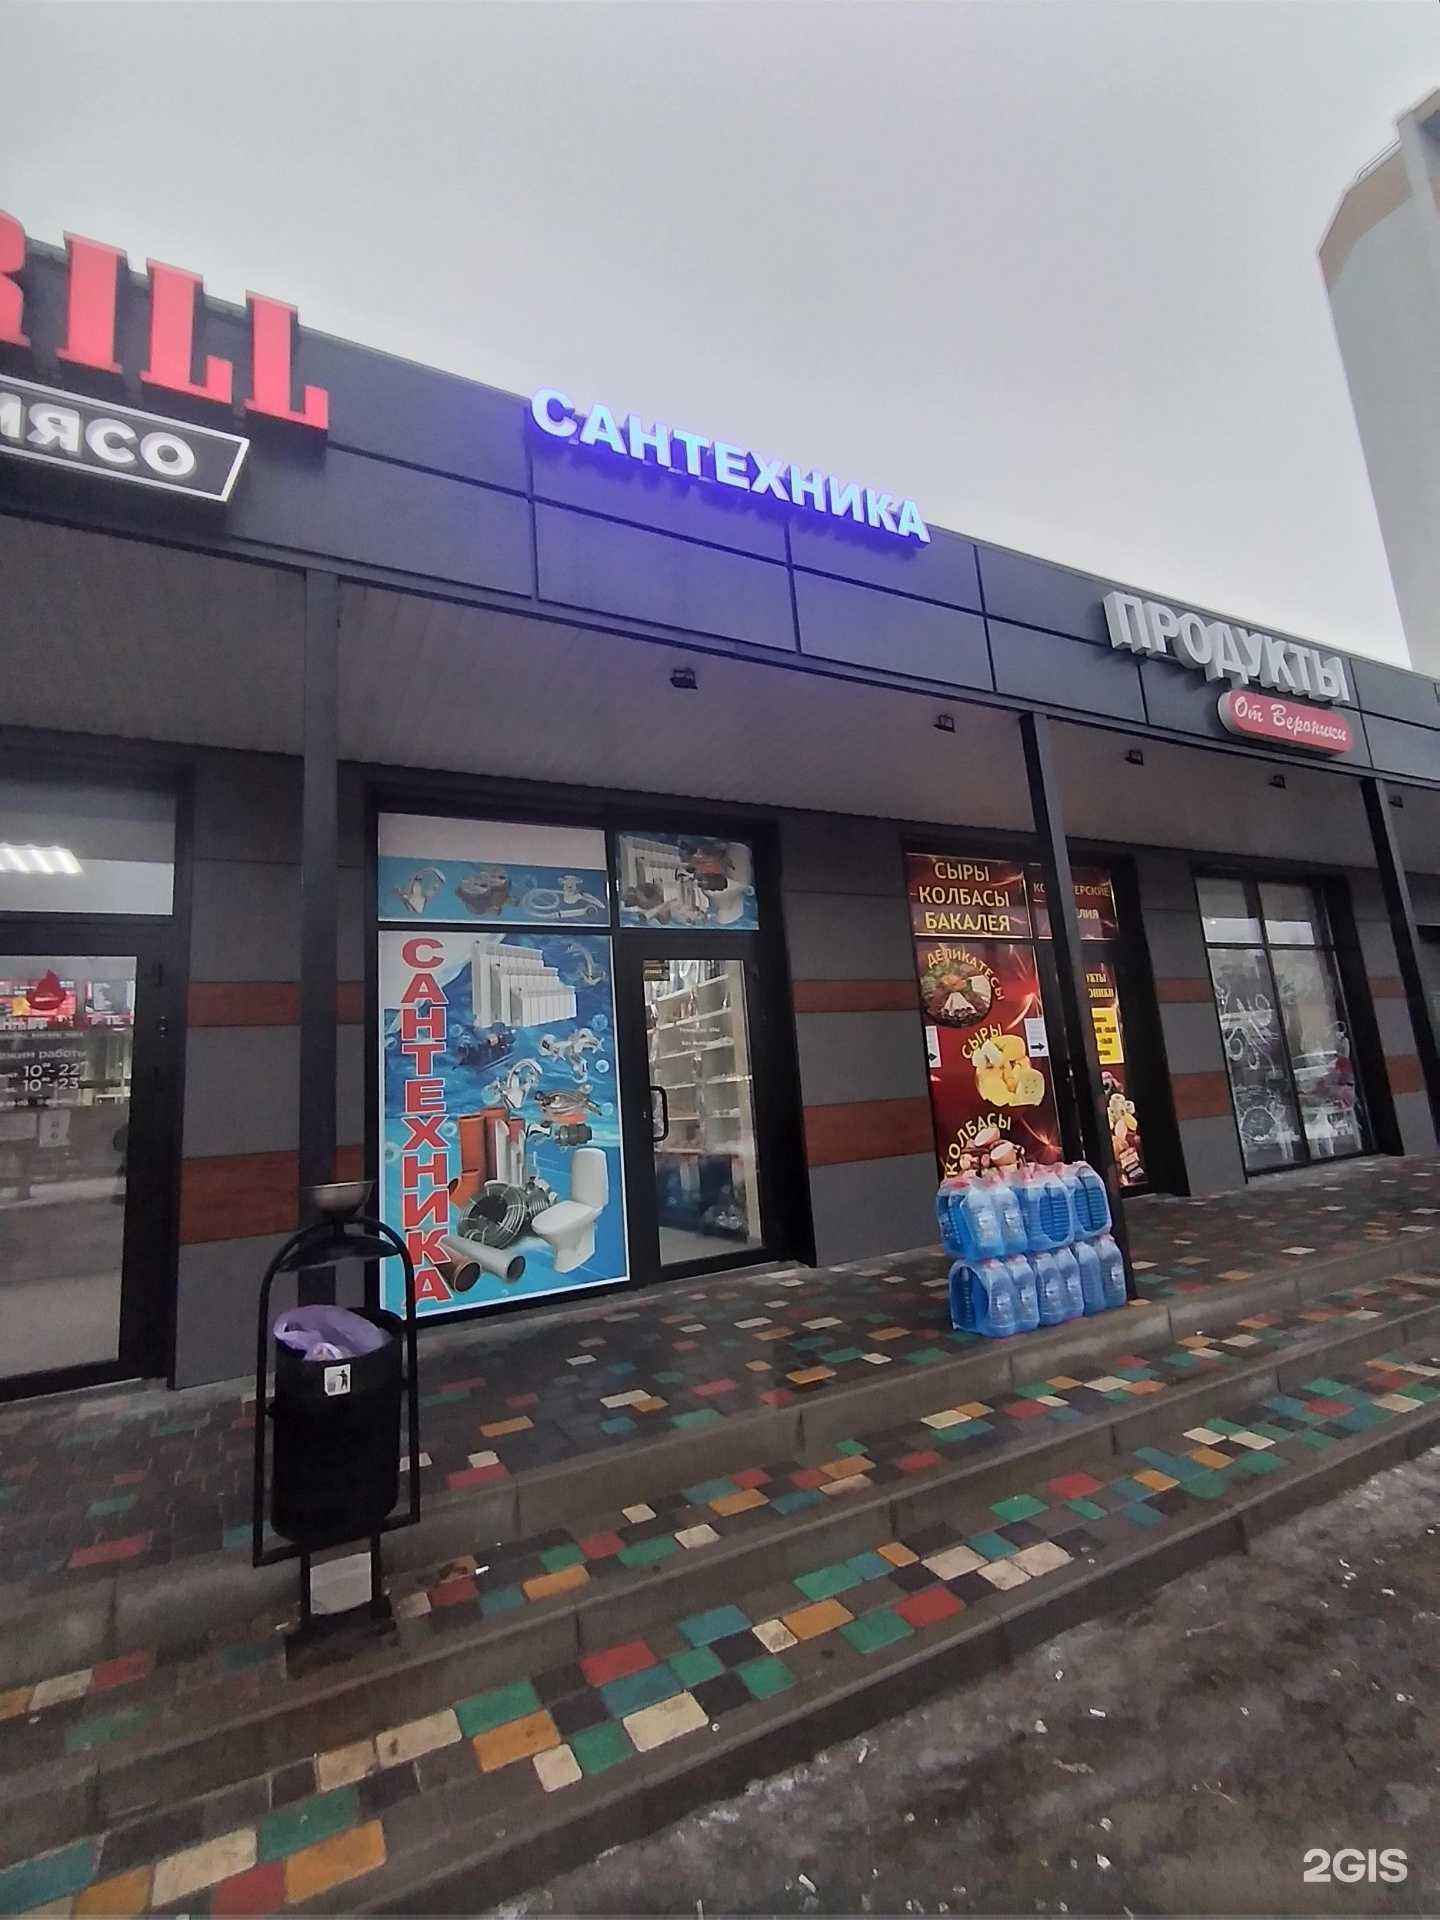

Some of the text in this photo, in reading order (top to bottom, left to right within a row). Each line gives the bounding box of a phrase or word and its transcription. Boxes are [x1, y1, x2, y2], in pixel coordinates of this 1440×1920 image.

[531, 389, 932, 545] САНТЕХНИКА
[1104, 592, 1350, 705] ПРОДУКТЫ
[918, 886, 1010, 908] КОЛБАСЫ
[934, 862, 990, 882] СЫРЫ
[925, 911, 1011, 932] БАКАЛЕЯ
[926, 947, 1006, 1001] ДЕЛИКАТЕСЫ
[961, 1023, 1003, 1060] СЫРЫ
[401, 936, 452, 1304] САНТЕХНИКА
[944, 1112, 1013, 1176] КОЛБАСЫ
